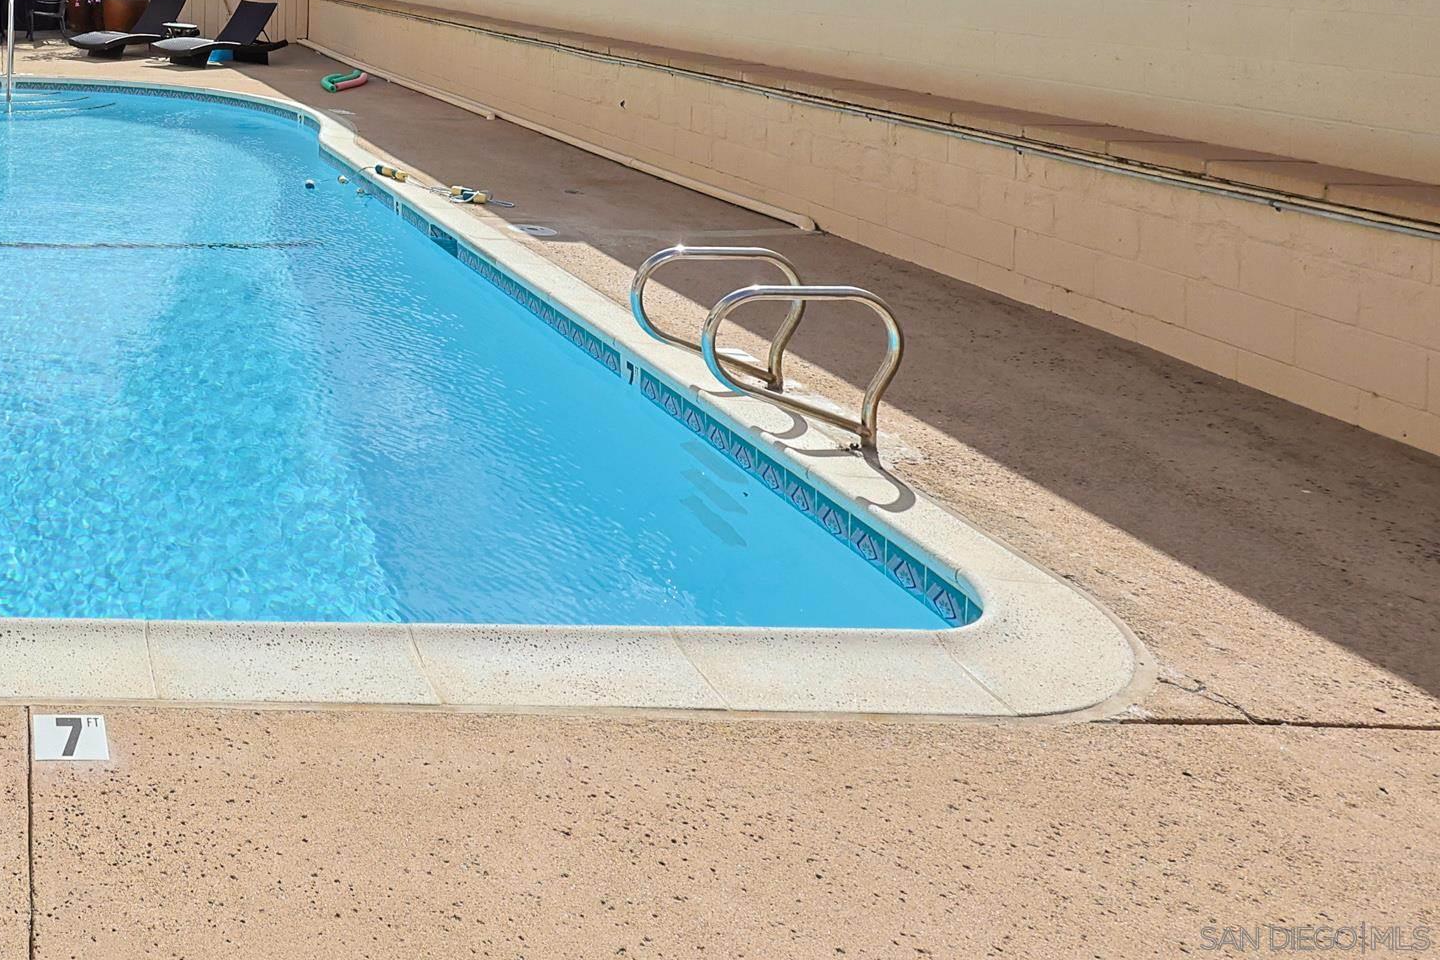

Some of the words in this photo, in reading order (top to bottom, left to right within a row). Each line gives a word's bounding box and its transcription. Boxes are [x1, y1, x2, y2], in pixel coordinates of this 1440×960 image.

[626, 361, 634, 385] 7
[56, 717, 82, 756] 7
[87, 717, 99, 727] FT
